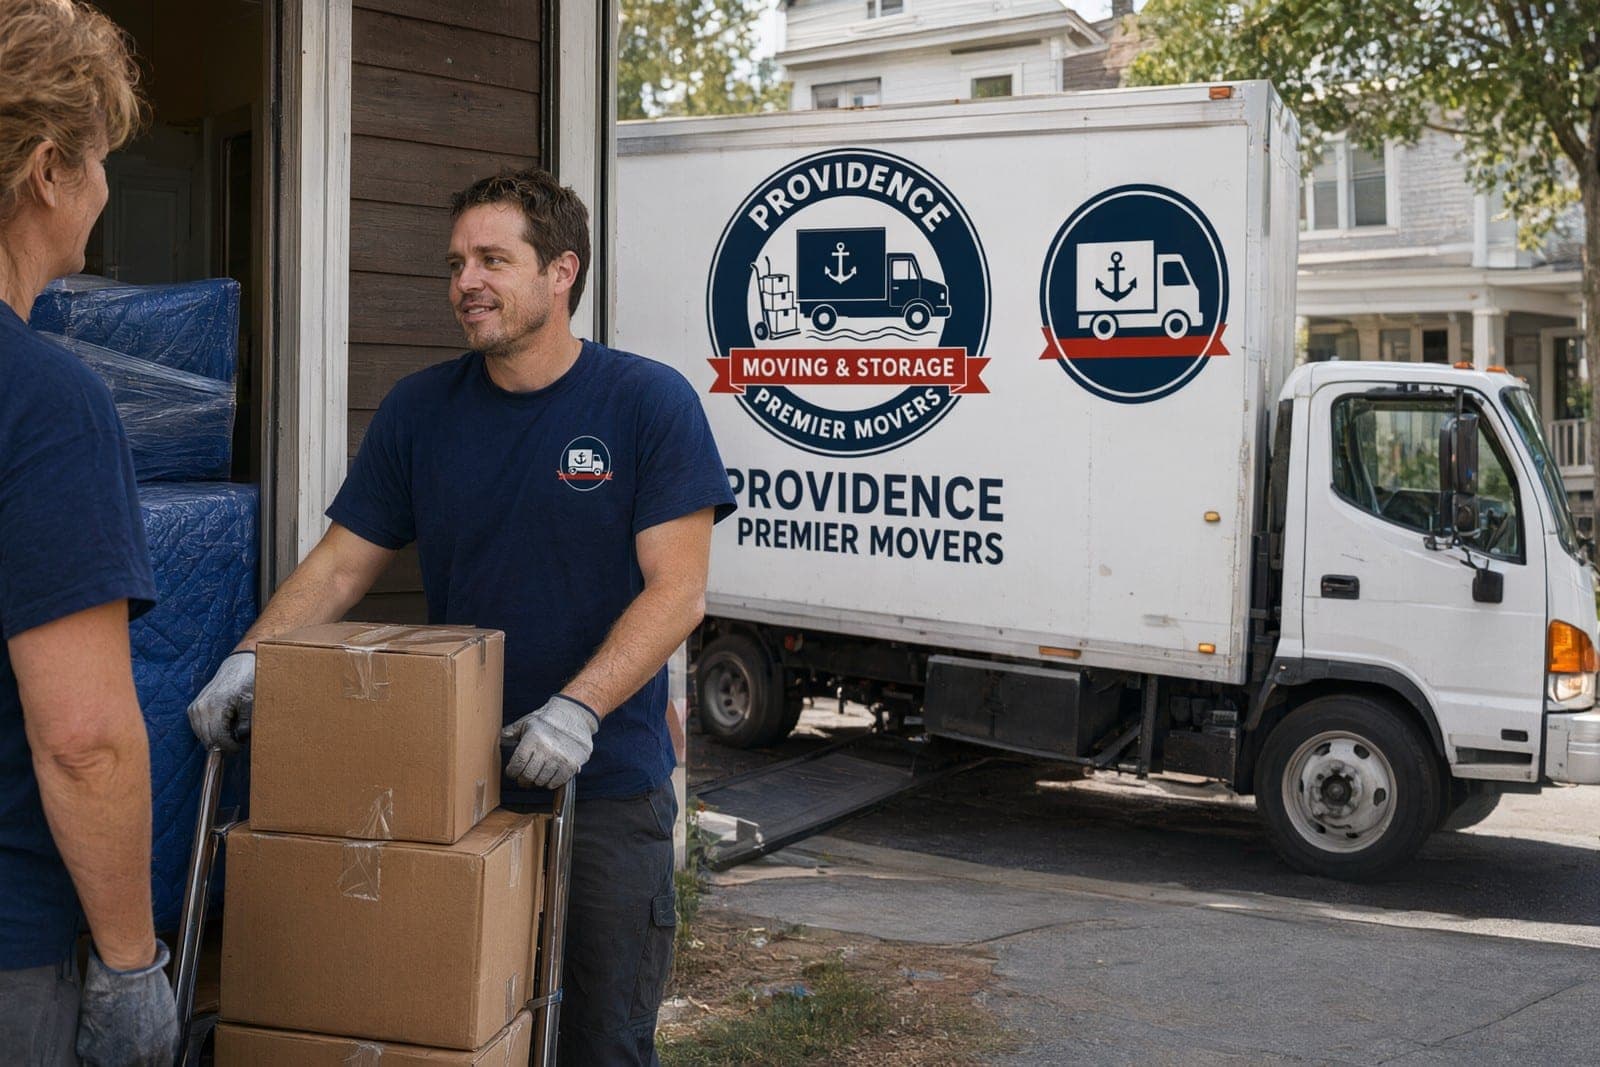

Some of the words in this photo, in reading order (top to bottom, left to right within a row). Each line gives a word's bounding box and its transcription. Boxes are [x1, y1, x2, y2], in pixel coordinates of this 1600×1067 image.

[748, 161, 951, 232] PROVIDENCE
[743, 358, 828, 377] MOVING
[835, 358, 850, 376] &
[857, 357, 955, 377] STORAGE
[754, 388, 846, 439] PREMIER
[855, 388, 941, 438] MOVERS
[738, 517, 859, 555] PREMIER
[870, 525, 1004, 565] MOVERS
